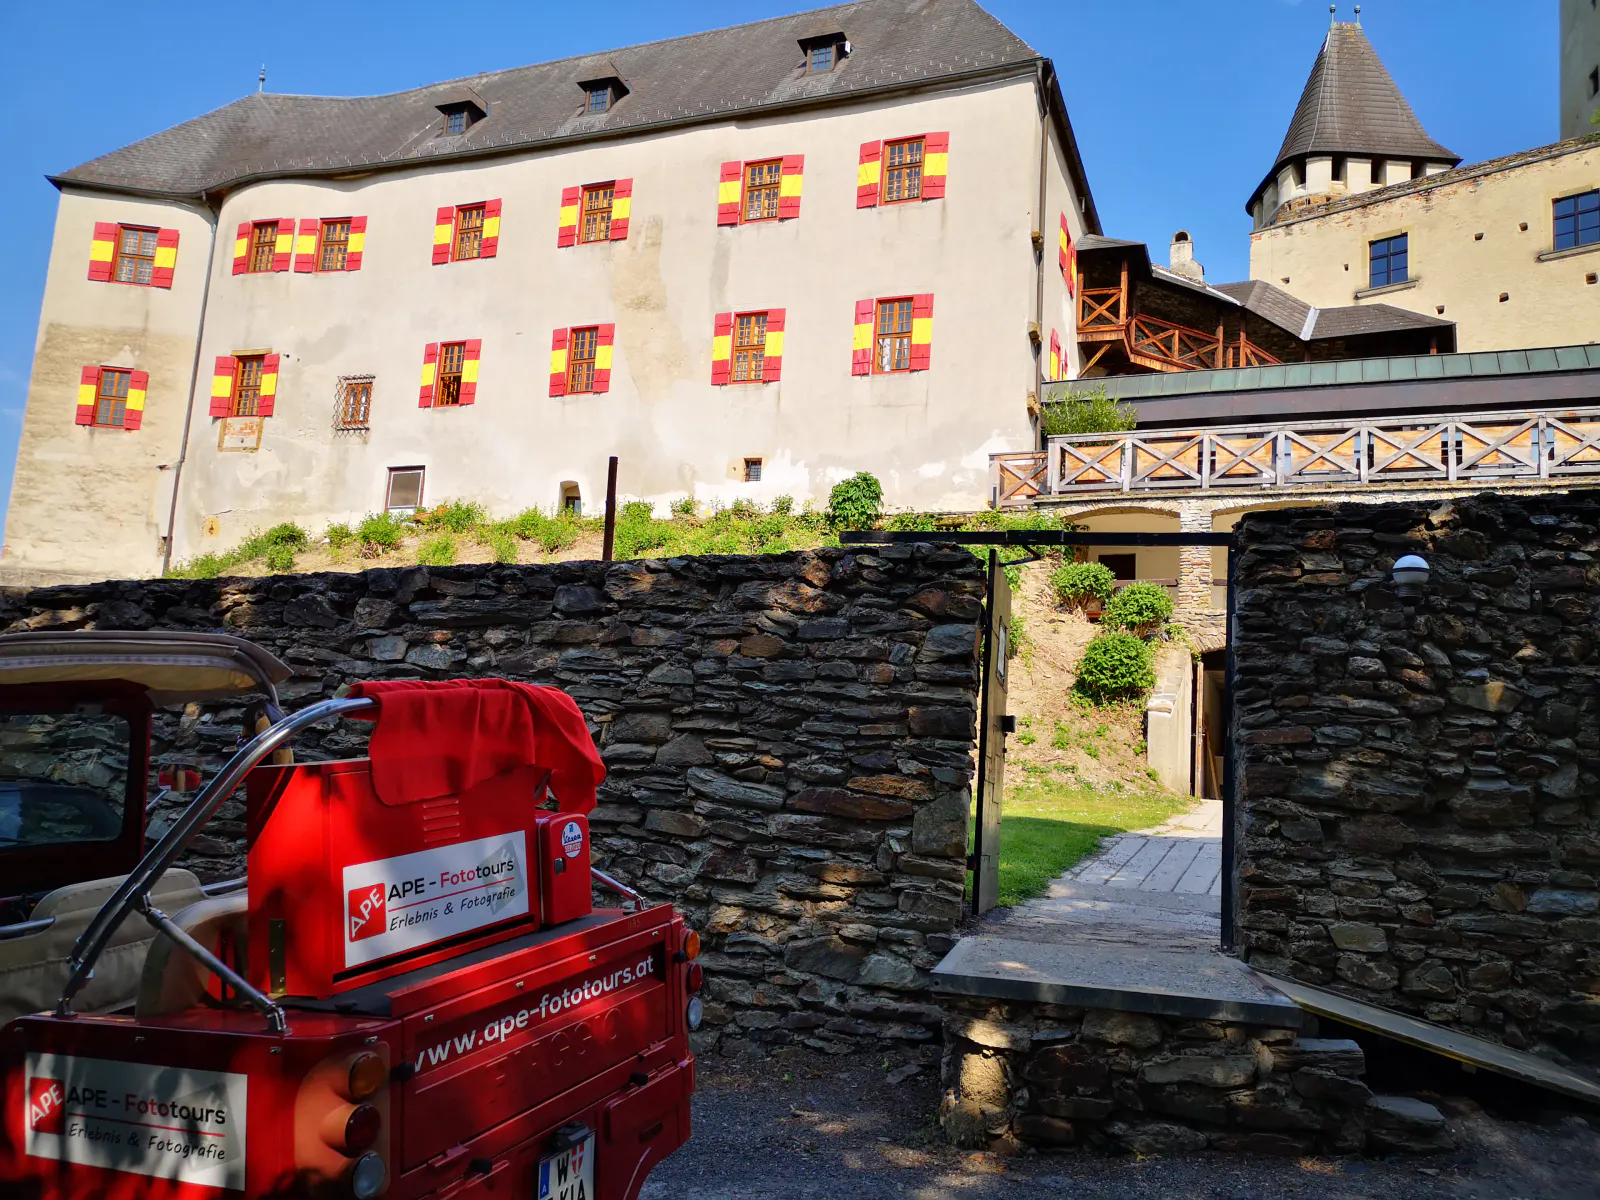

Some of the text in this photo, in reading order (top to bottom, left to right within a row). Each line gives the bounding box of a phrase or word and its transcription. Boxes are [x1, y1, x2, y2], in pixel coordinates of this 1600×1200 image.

[388, 877, 425, 902] APE
[440, 859, 514, 889] Fototours
[350, 888, 385, 938] APE
[389, 886, 516, 932] Erlebnis & Fotografie
[30, 1083, 64, 1127] APE
[66, 1086, 107, 1109] APE
[125, 1093, 226, 1125] Fototours
[68, 1123, 226, 1160] Erlebnis & Fotografie
[557, 1153, 570, 1187] W
